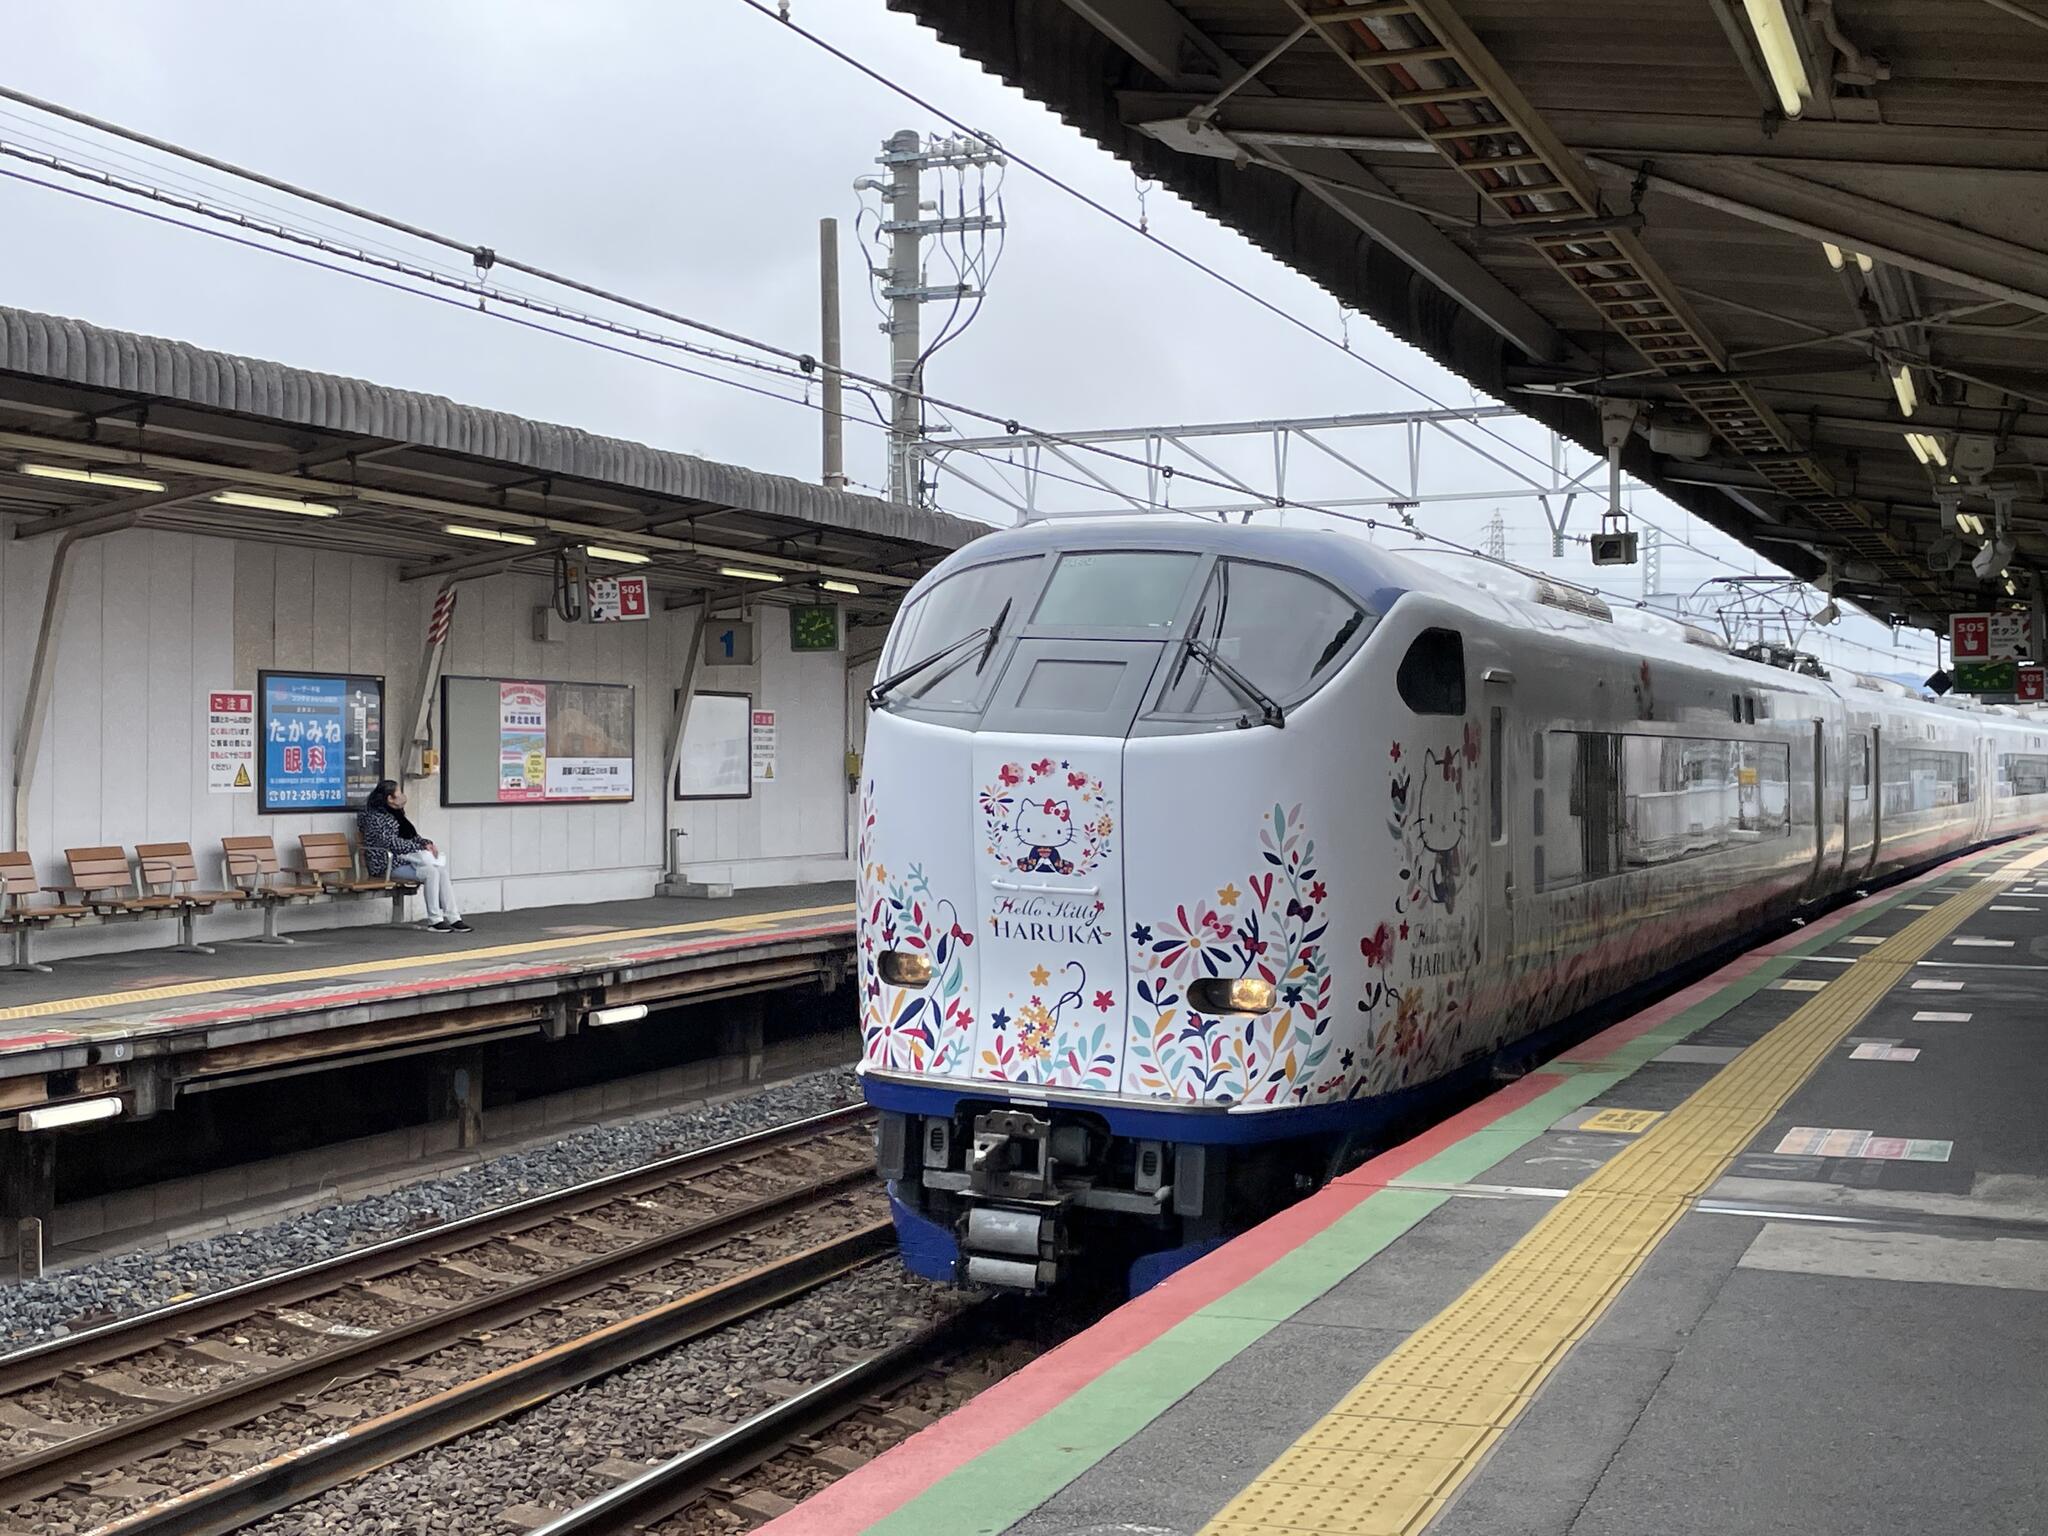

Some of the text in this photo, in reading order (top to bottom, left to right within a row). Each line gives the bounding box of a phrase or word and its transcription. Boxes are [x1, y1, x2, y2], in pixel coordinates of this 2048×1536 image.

[621, 585, 641, 594] SOS
[1958, 623, 1985, 632] SOS
[720, 630, 734, 657] 1
[2021, 674, 2042, 682] SOS
[214, 697, 249, 711] ご注意
[270, 718, 341, 743] たかみね
[284, 746, 327, 774] 眼科
[992, 895, 1101, 927] Hello Kitty
[994, 919, 1103, 945] HARUKA
